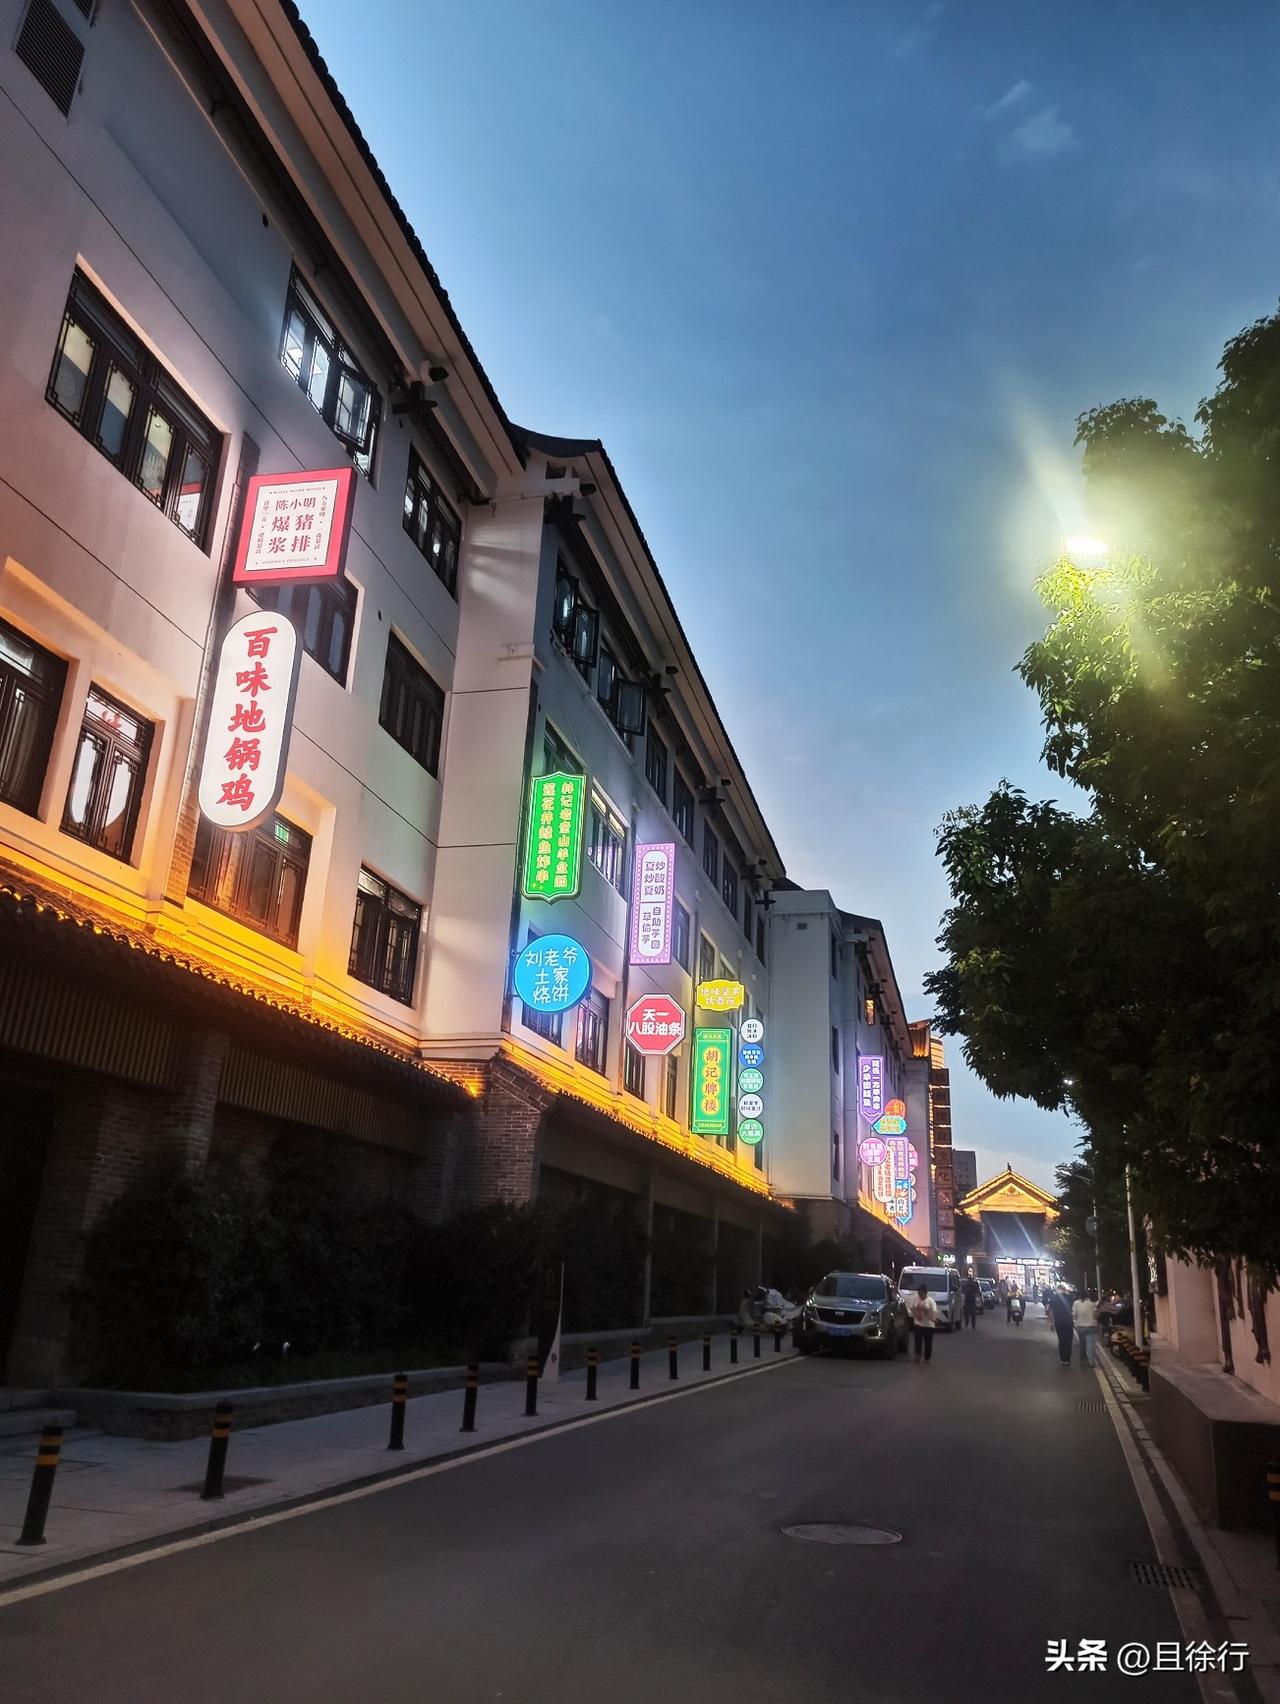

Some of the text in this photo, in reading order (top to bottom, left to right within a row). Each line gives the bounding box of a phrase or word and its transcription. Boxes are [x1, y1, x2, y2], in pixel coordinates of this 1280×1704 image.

[275, 497, 317, 512] 陈小明
[216, 627, 278, 812] 百味地锅鸡
[525, 946, 578, 967] 刘老爷
[534, 965, 569, 986] 土家
[533, 983, 569, 1004] 烧饼
[642, 1008, 670, 1022] 天一
[629, 1021, 681, 1036] 八股油条
[704, 1050, 718, 1112] 胡记牌楼
